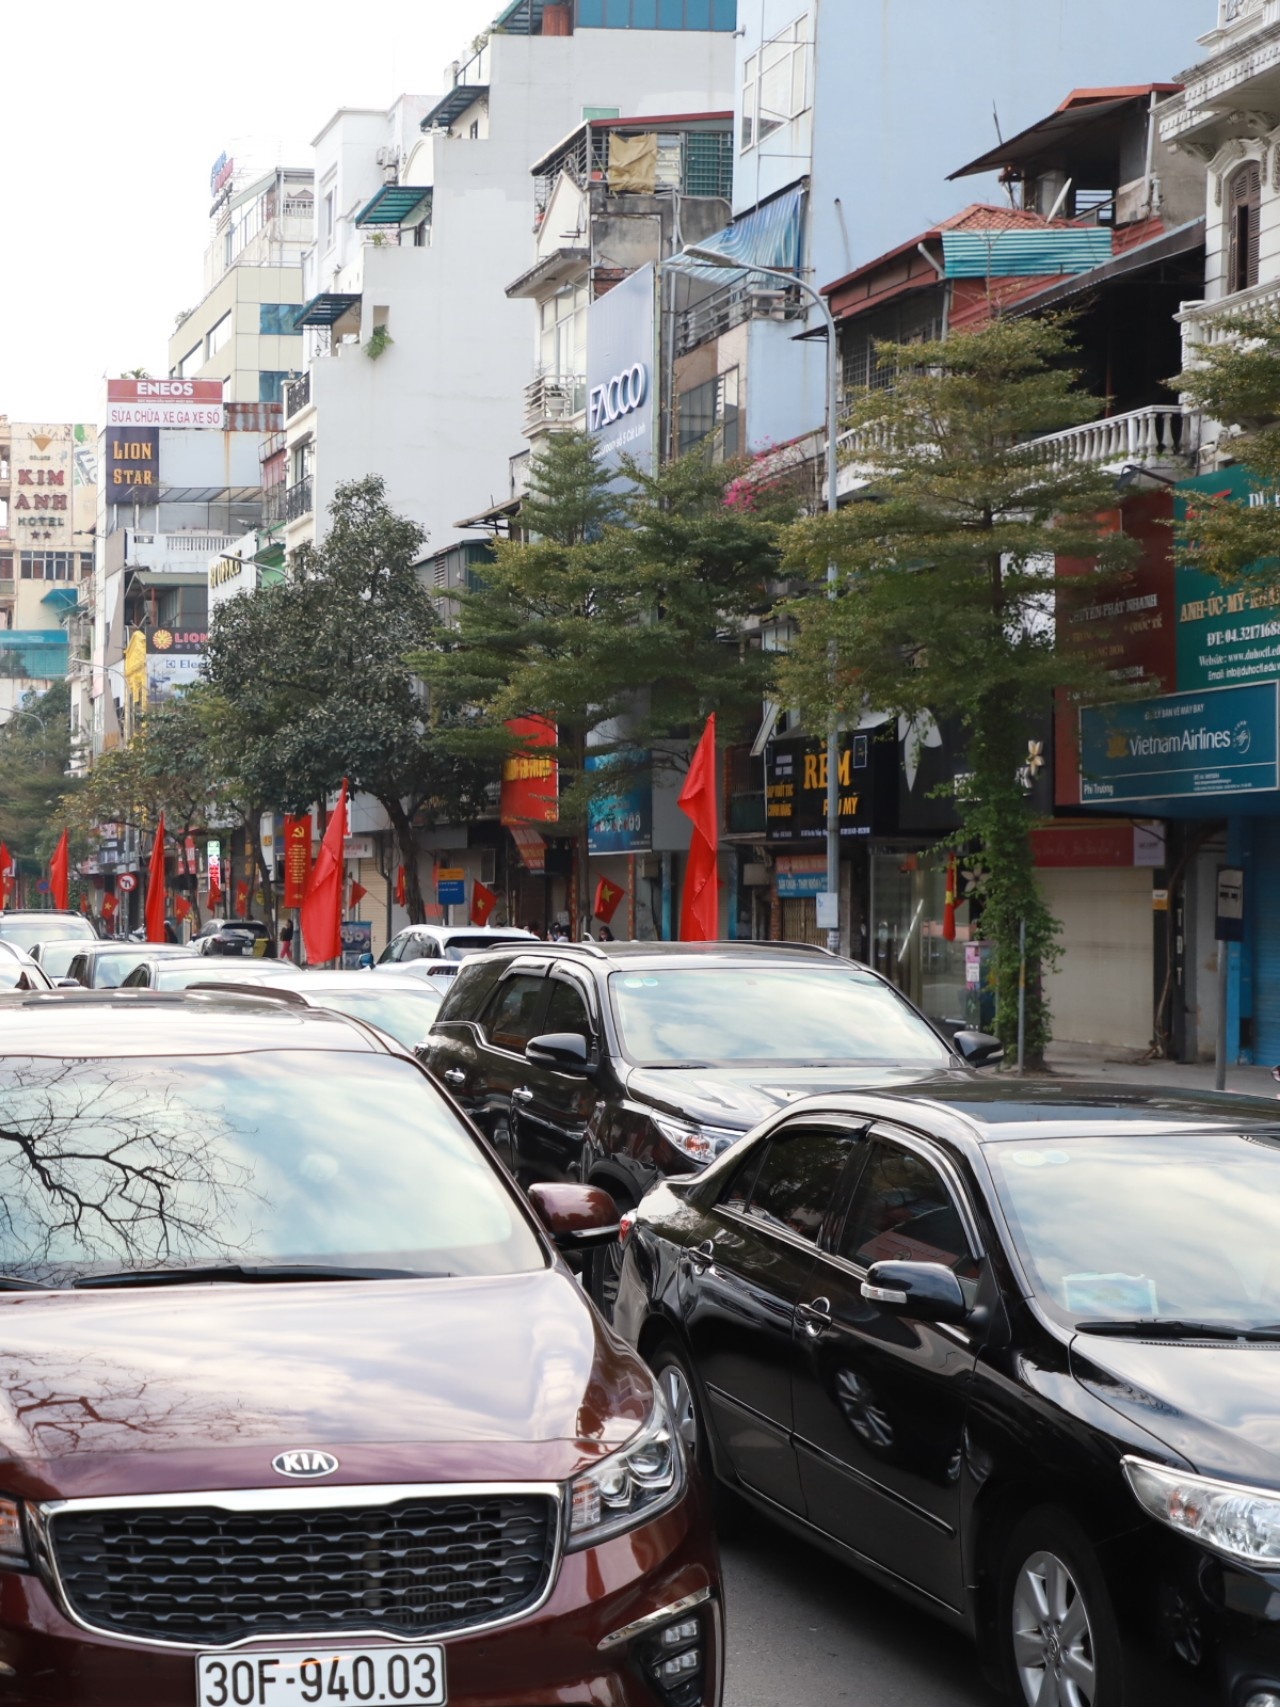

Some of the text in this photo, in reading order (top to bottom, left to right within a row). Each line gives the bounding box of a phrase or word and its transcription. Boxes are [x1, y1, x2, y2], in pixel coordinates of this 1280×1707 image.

[136, 382, 194, 396] ENEOS
[133, 408, 160, 423] CHỮA
[162, 411, 175, 424] XE
[176, 411, 190, 424] GA
[192, 411, 204, 424] XE
[206, 406, 220, 424] SỐ
[113, 440, 152, 460] LION
[17, 468, 65, 486] KIM
[113, 468, 153, 485] STAR
[14, 493, 67, 511] ANH
[17, 516, 65, 527] HOTEL
[1129, 726, 1231, 757] Vietnam Airlines
[283, 1453, 329, 1472] KIA
[204, 1653, 437, 1707] 30F-940.03
